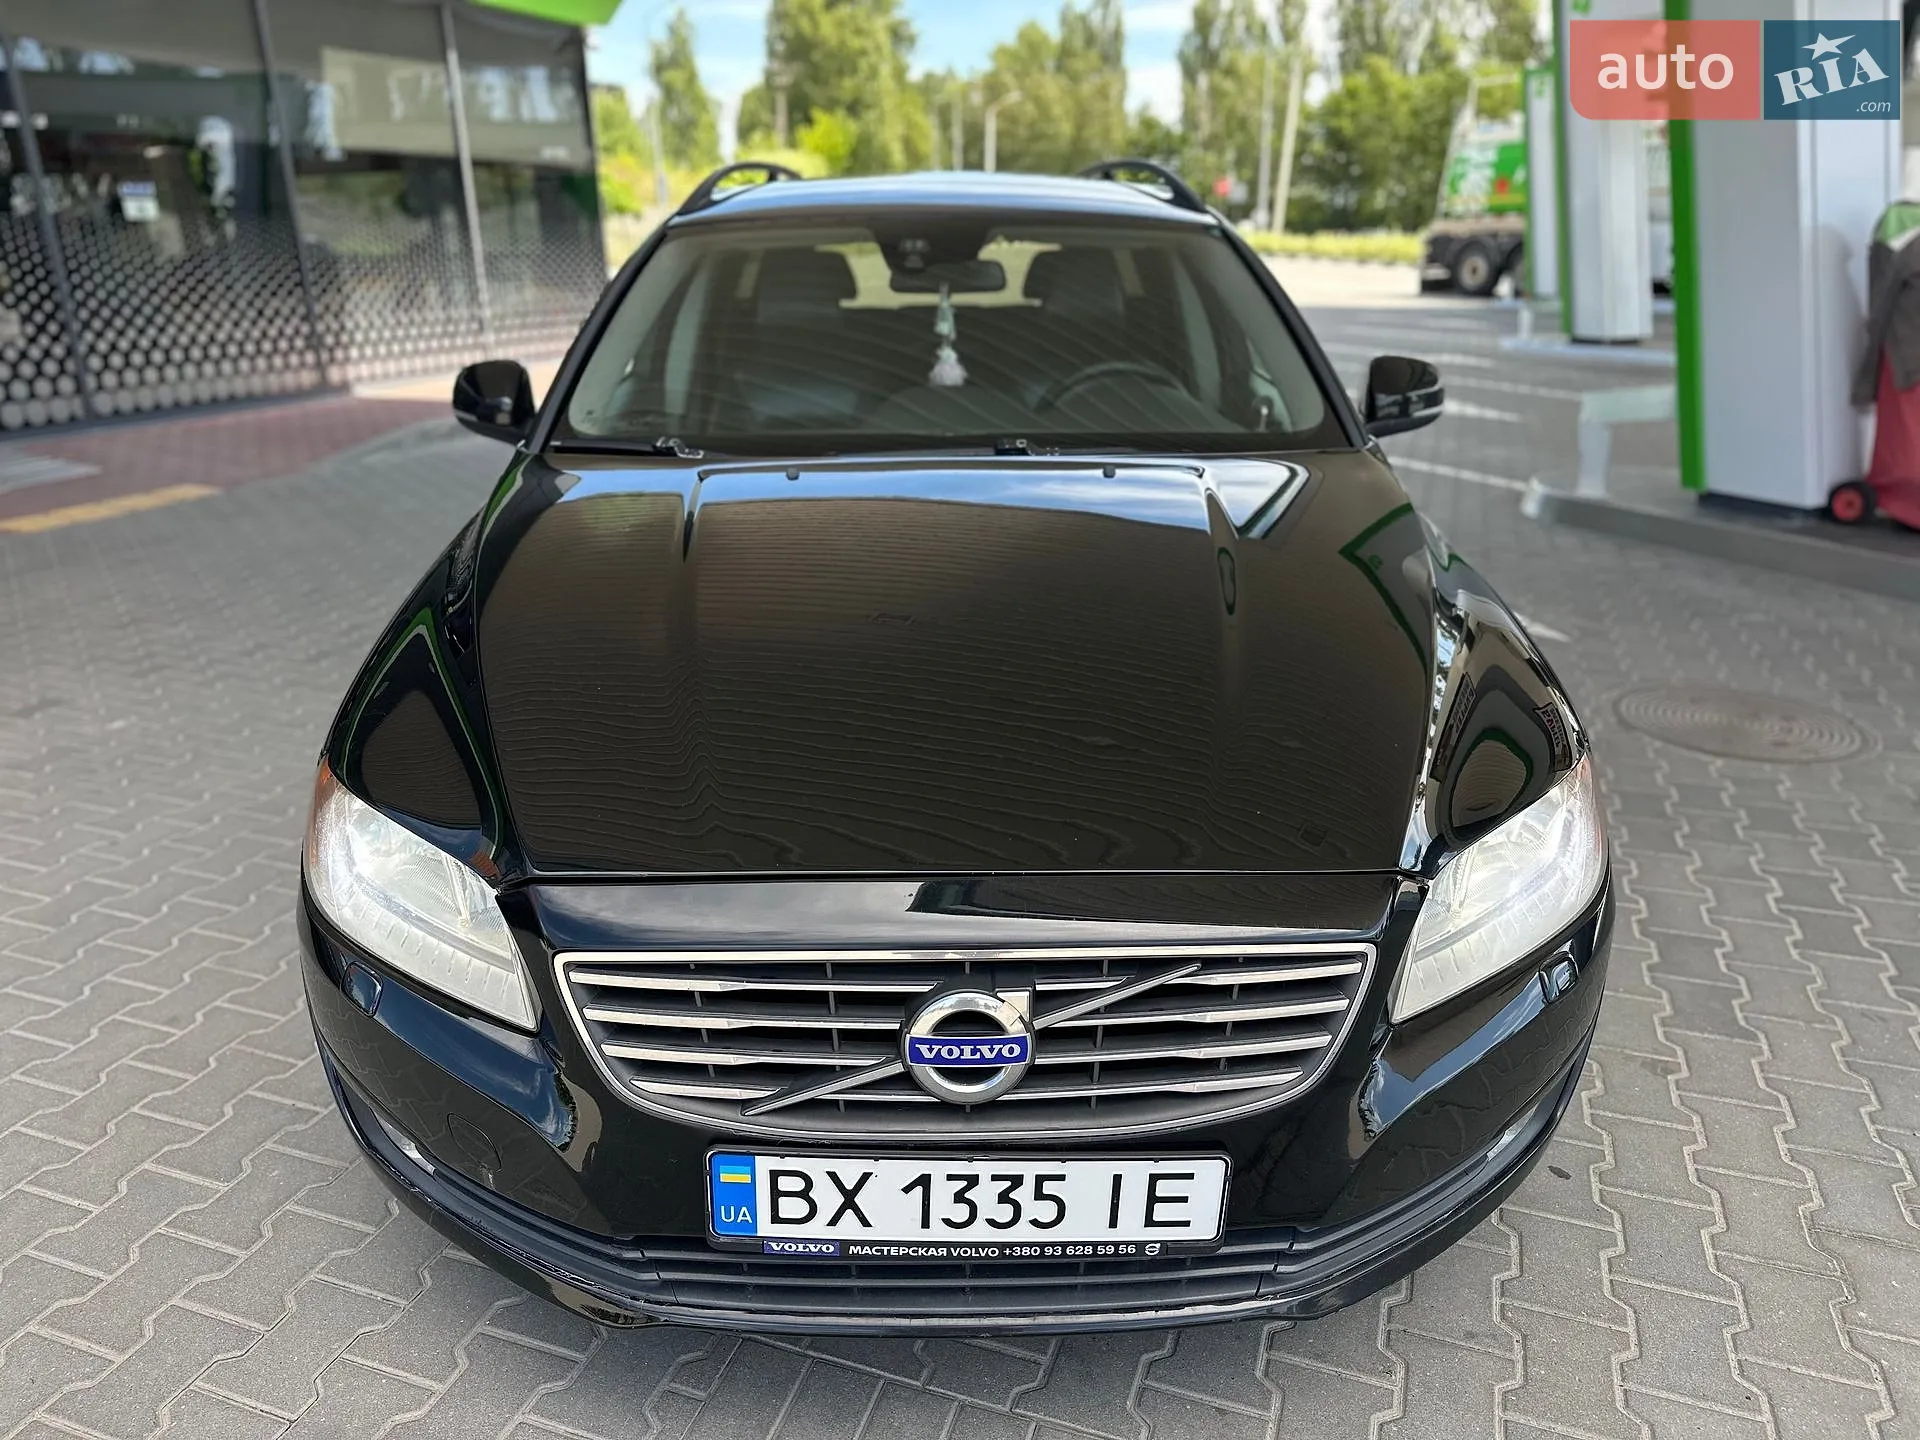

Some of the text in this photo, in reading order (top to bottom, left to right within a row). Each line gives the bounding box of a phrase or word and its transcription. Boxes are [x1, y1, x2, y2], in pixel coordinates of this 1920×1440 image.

[915, 1043, 1021, 1060] VOLVO
[768, 1169, 1195, 1230] BX 1335 IE
[720, 1205, 753, 1224] UA
[768, 1241, 836, 1254] VOLVO
[848, 1244, 1137, 1258] МАСТЕРСКАЯ VOLVO +380 93 628 59 56
